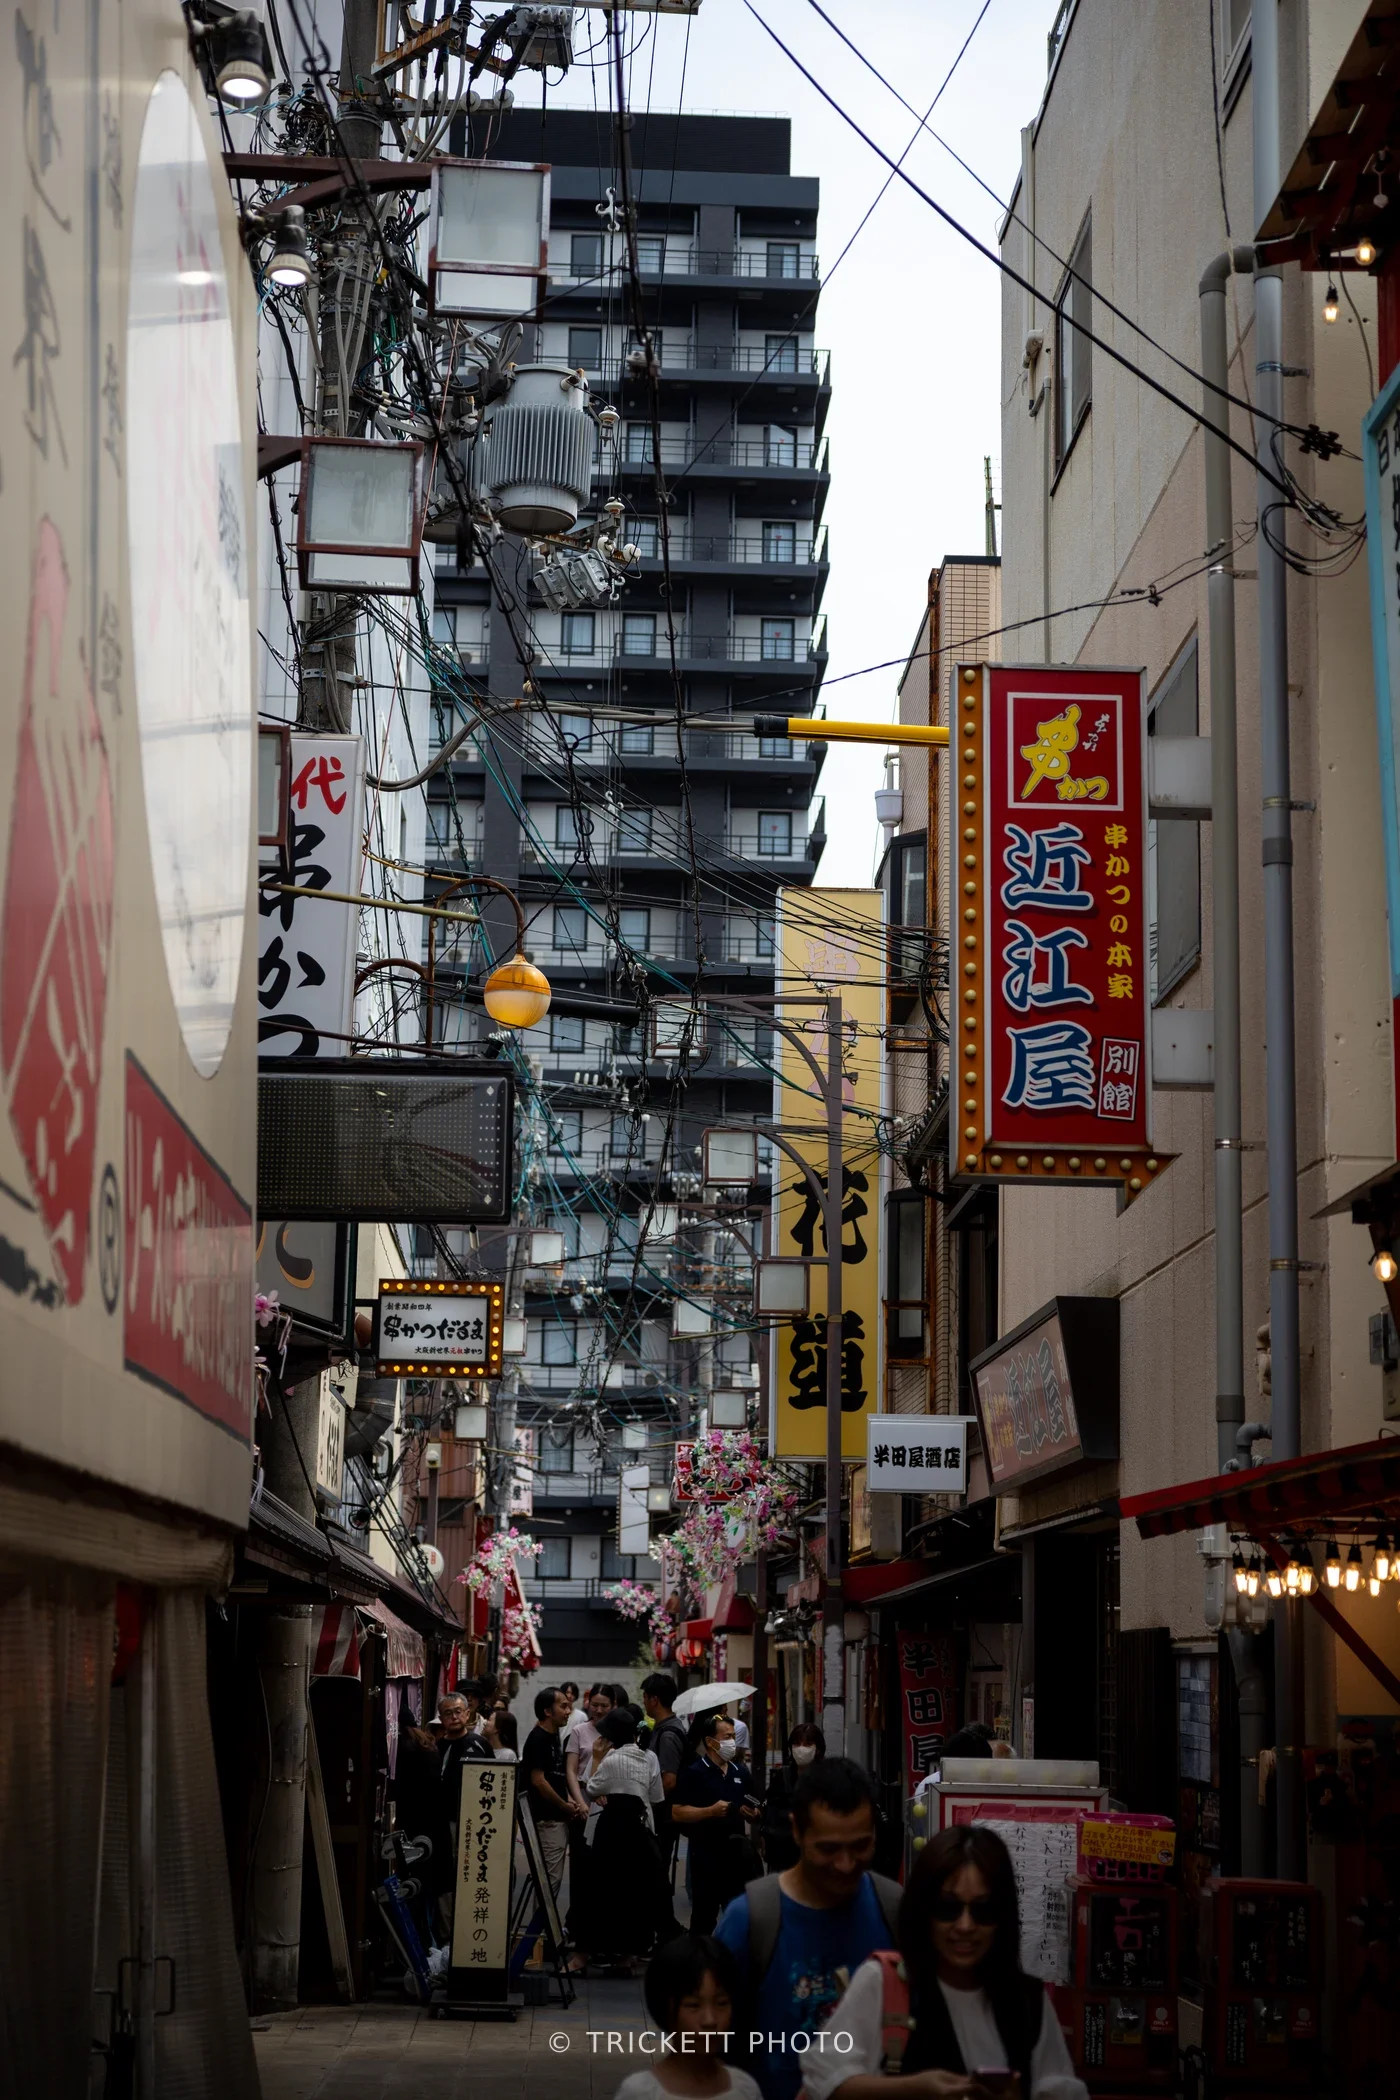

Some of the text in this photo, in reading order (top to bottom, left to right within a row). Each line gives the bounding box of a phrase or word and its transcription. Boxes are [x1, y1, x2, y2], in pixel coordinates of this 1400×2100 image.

[1020, 703, 1110, 800] 串かつ
[258, 810, 331, 1056] 串かつ
[1104, 823, 1134, 999] 串かつの本家
[1001, 822, 1097, 1112] 近江屋
[1103, 1043, 1136, 1112] 別館
[383, 1314, 484, 1342] 串かつだるま
[385, 1302, 432, 1312] 創業昭和四年
[874, 1444, 960, 1469] 半田屋酒店
[903, 1640, 945, 1792] 半田屋
[1083, 1838, 1157, 1855] ONLY CAPSULES
[1089, 1846, 1152, 1861] NO LITTERING
